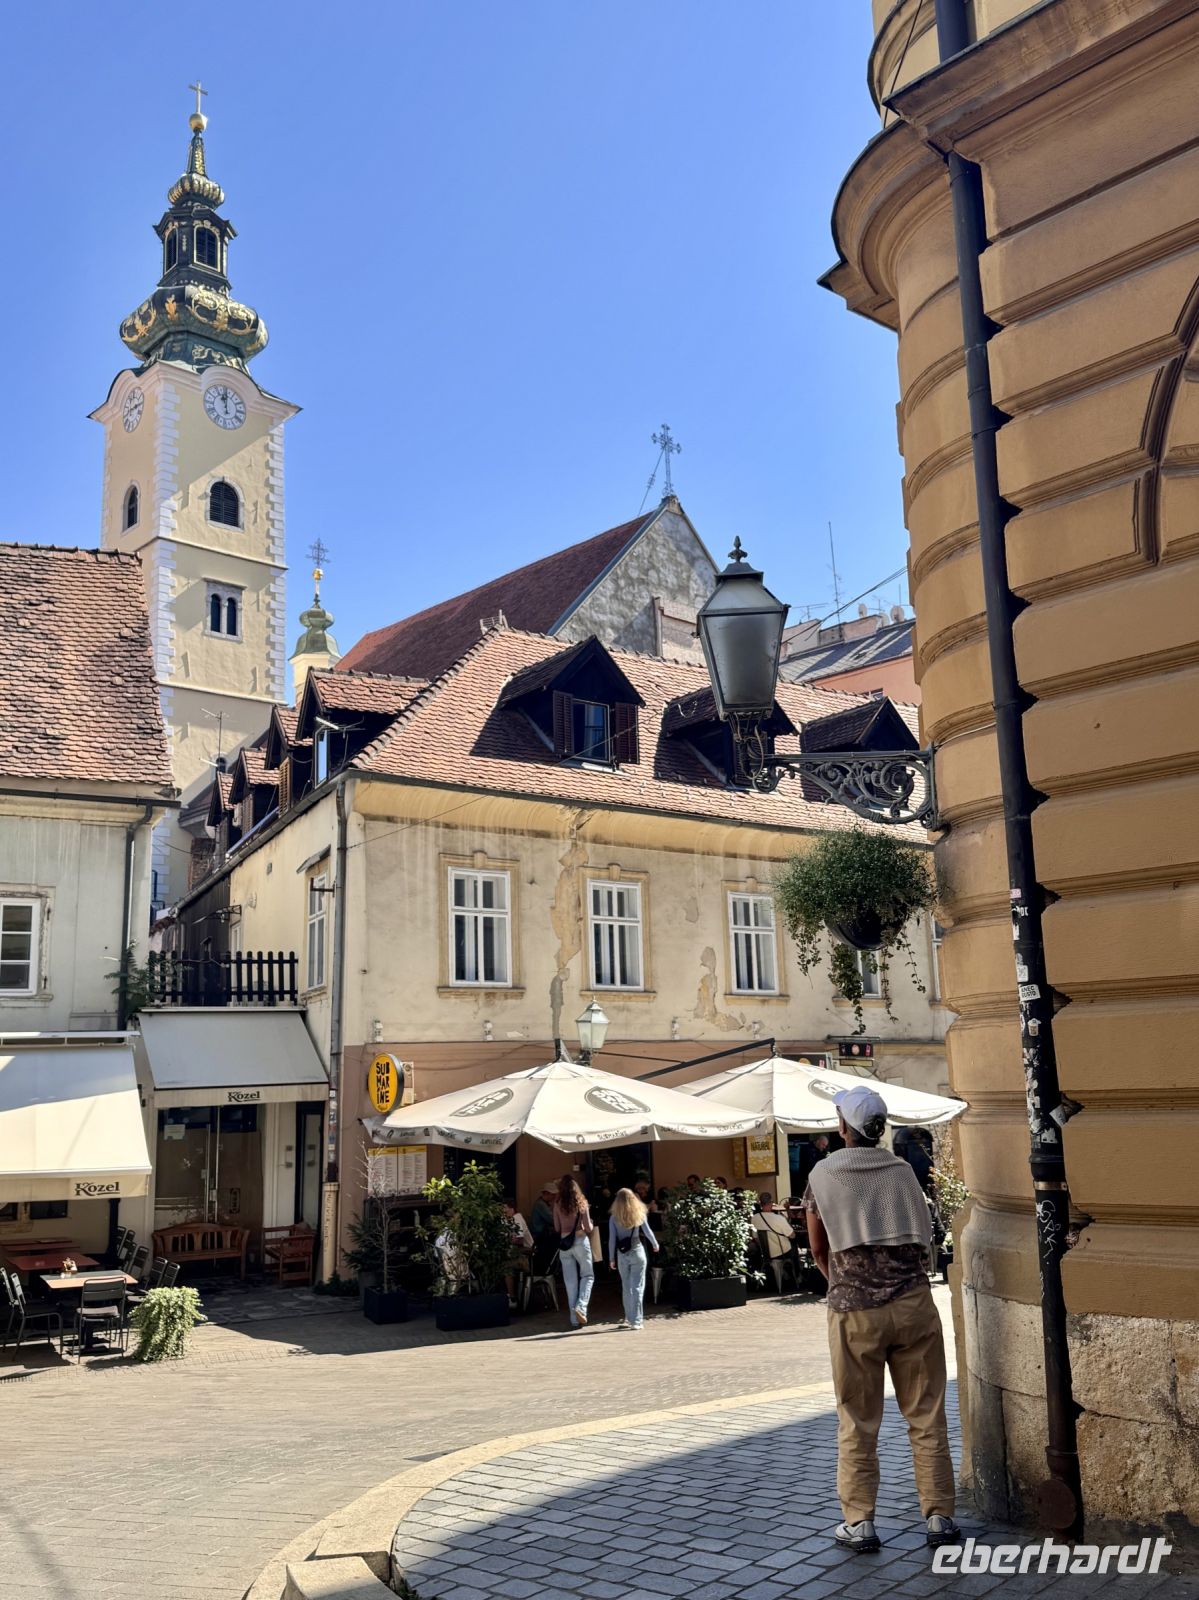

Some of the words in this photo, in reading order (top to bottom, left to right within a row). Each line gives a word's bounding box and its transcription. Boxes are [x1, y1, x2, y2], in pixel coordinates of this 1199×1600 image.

[376, 1062, 390, 1075] SUB
[376, 1075, 390, 1089] MAR
[228, 1091, 261, 1102] Kozel
[75, 1181, 120, 1197] Kozel
